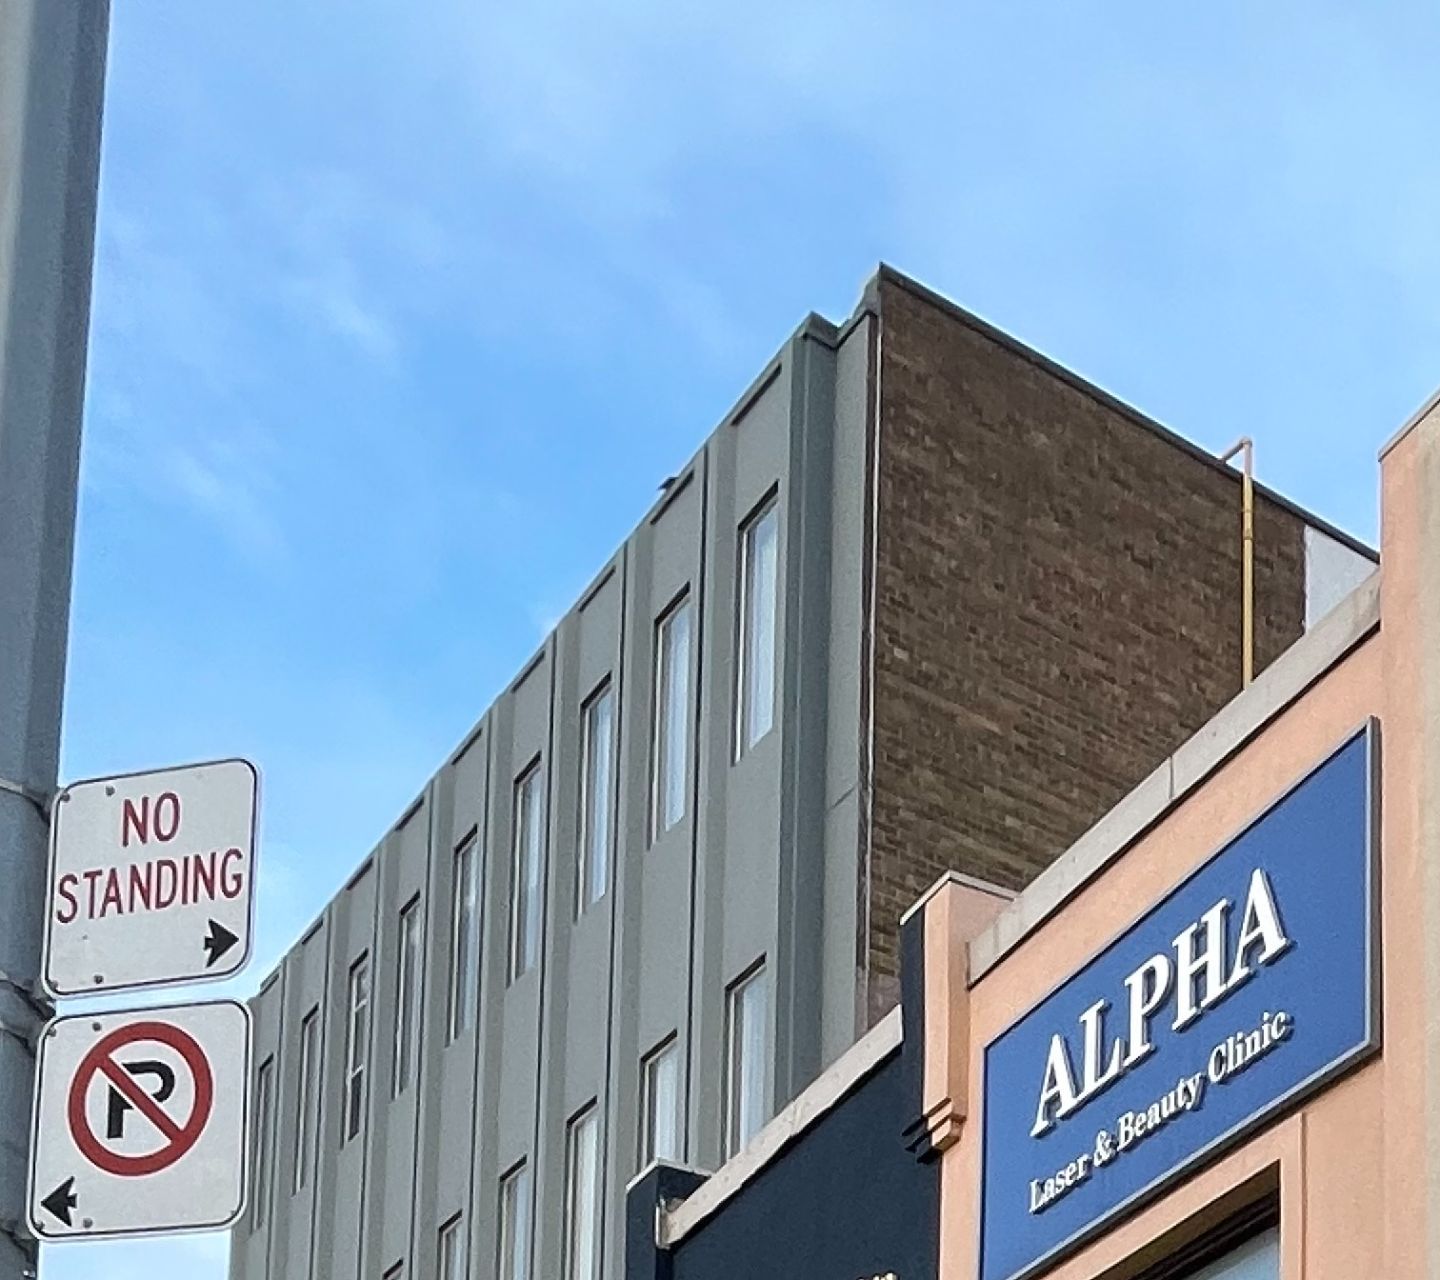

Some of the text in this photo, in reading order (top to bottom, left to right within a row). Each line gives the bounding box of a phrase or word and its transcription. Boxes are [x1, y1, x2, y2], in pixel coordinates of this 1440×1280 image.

[56, 848, 244, 924] STANDING
[122, 792, 181, 847] NO
[1030, 866, 1293, 1138] ALPHA
[1028, 1008, 1293, 1216] Laser & Beauty Clinic
